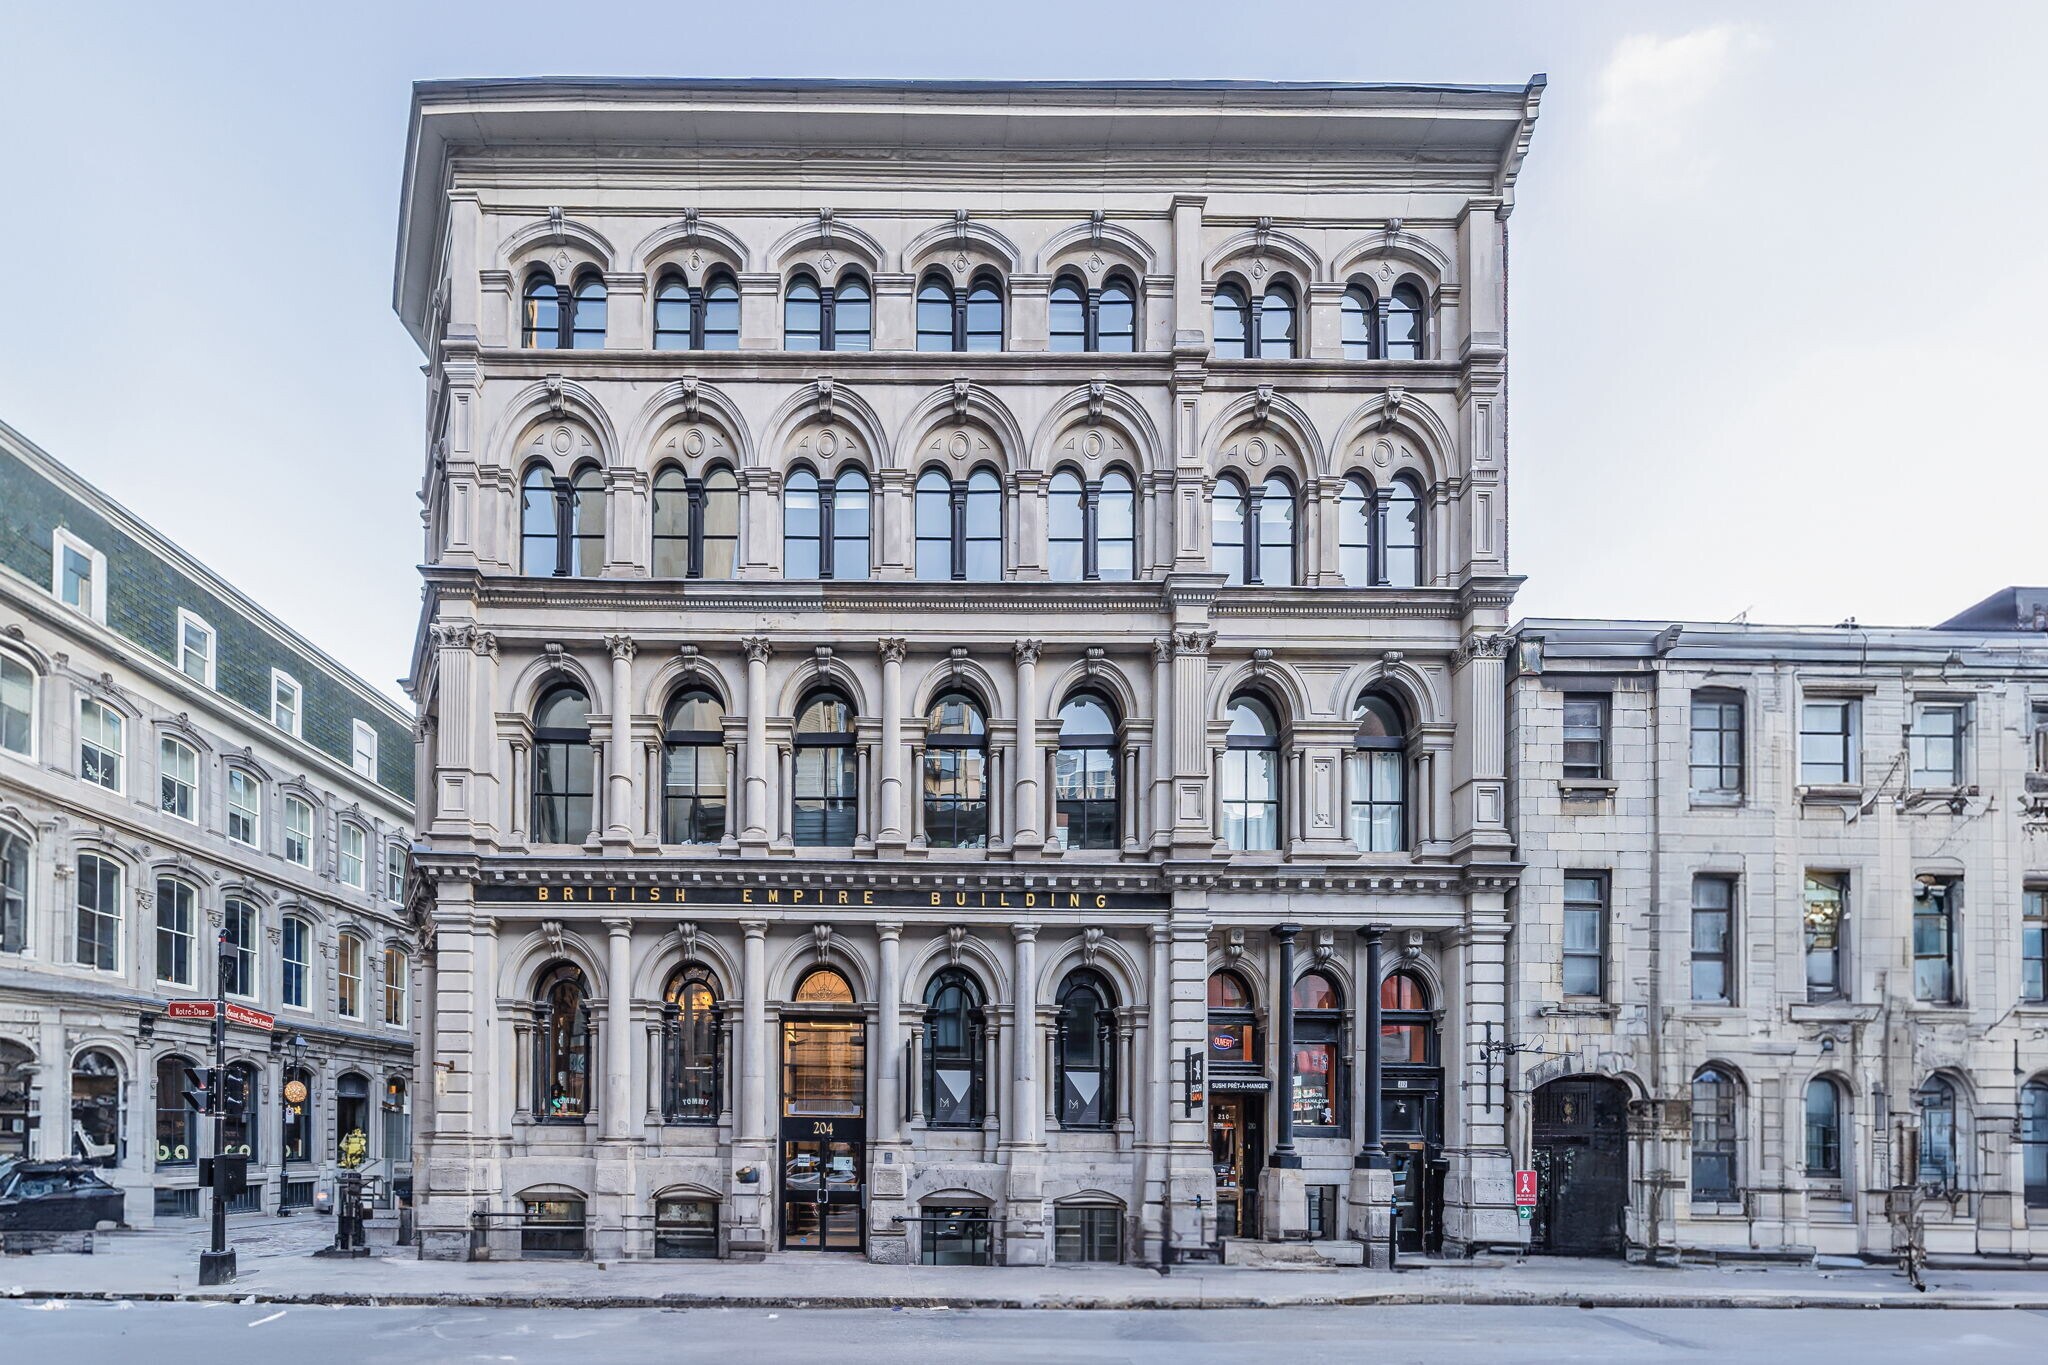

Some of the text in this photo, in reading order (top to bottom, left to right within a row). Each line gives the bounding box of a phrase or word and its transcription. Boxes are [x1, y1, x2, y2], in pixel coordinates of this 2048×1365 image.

[538, 887, 1106, 908] BRITISH EMPIRE BUILDING
[175, 1007, 210, 1016] Notre-Dame
[1214, 1037, 1233, 1048] OUVERT
[554, 1097, 581, 1105] TOMMY
[682, 1098, 709, 1106] TOMMY
[813, 1121, 834, 1136] 204
